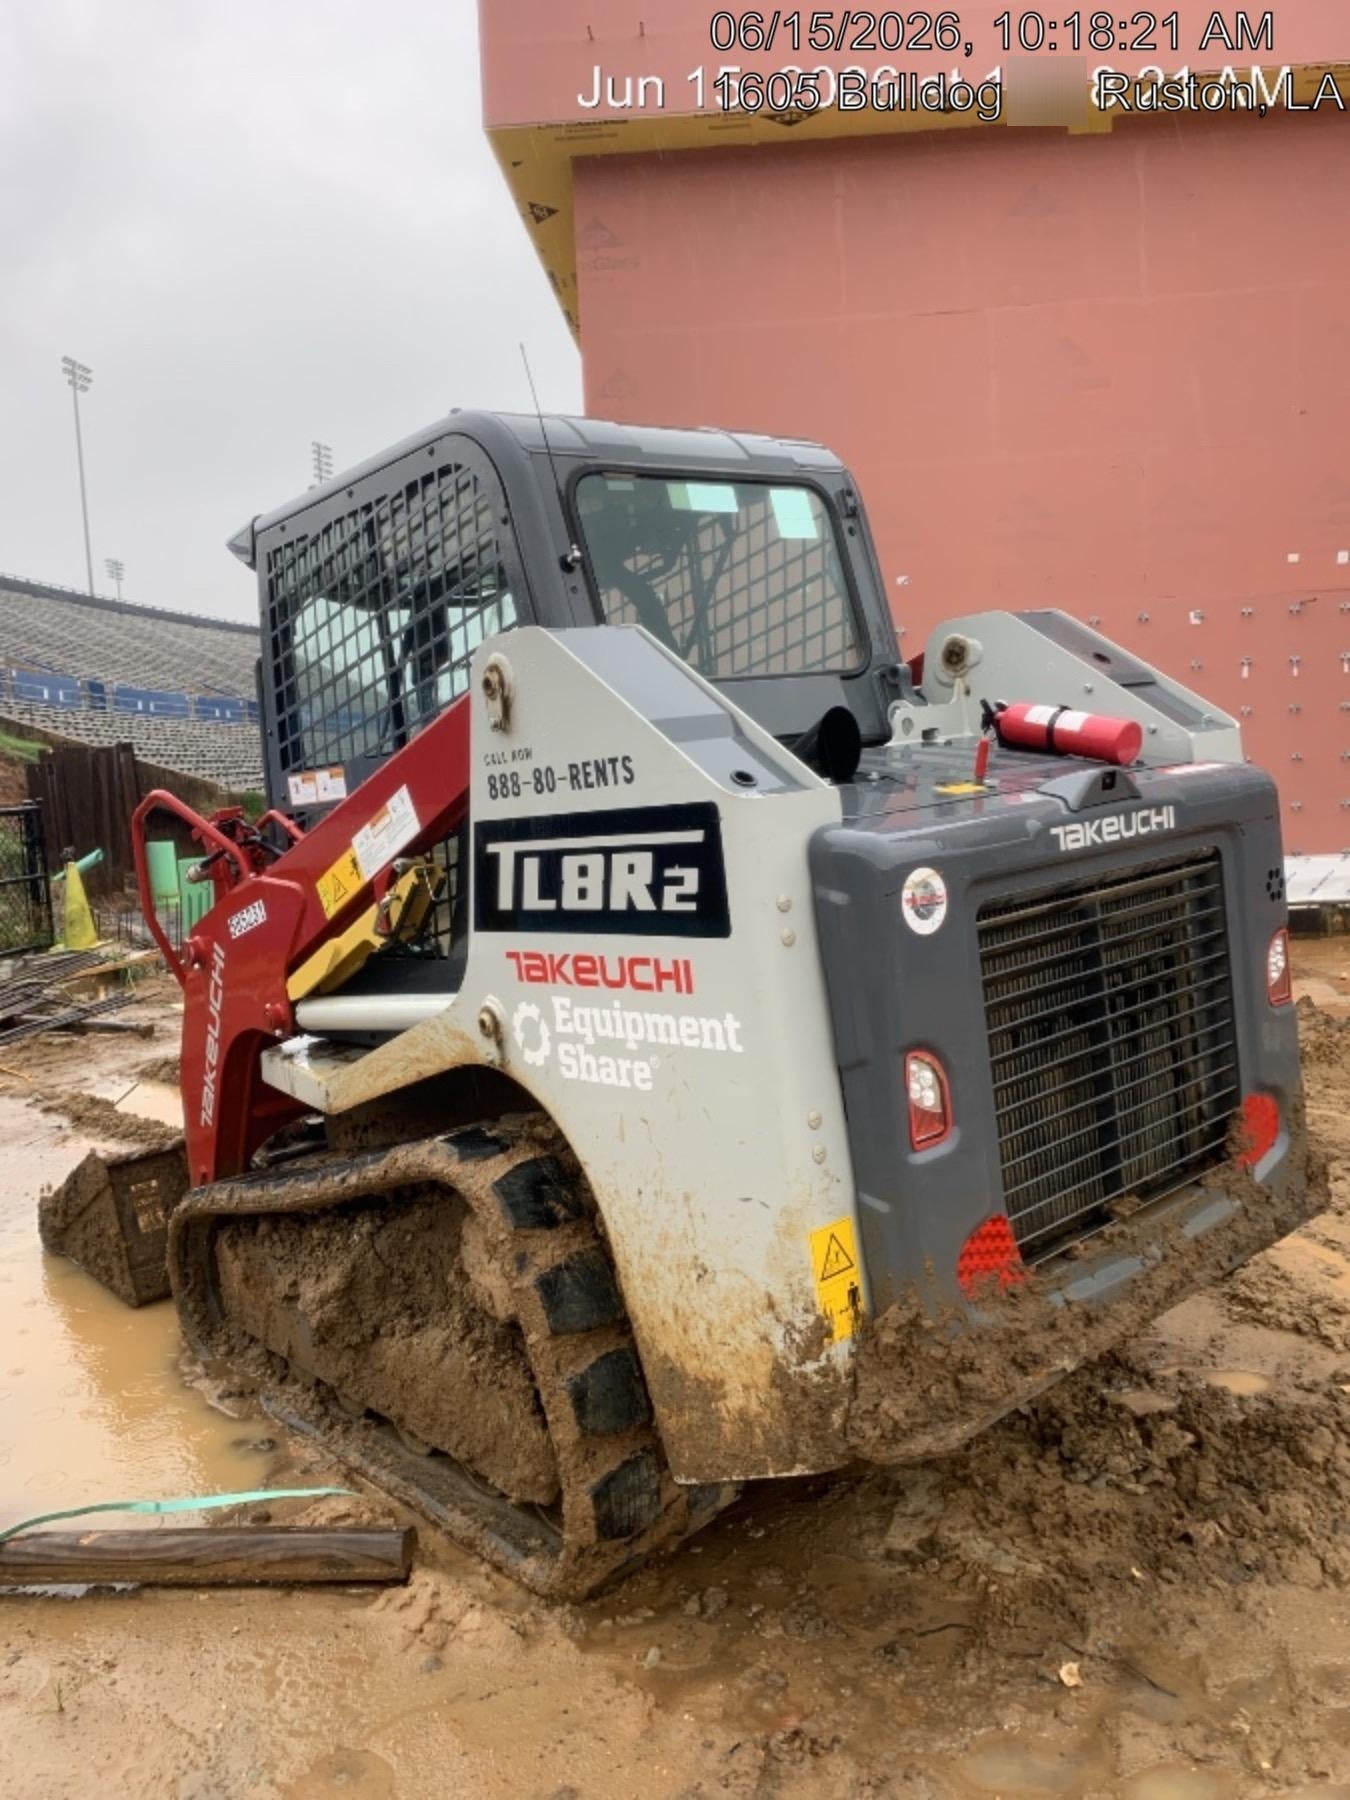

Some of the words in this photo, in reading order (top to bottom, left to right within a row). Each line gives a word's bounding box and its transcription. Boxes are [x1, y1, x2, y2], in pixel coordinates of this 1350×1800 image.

[487, 755, 635, 801] 888-80-RENTS
[1049, 804, 1176, 852] TAKEUCHI
[486, 829, 705, 912] TL8R2
[505, 950, 694, 995] TAKEUCHI
[200, 941, 226, 1128] TAKEUCHI
[551, 995, 744, 1053] Equipment
[557, 1042, 653, 1092] Share
